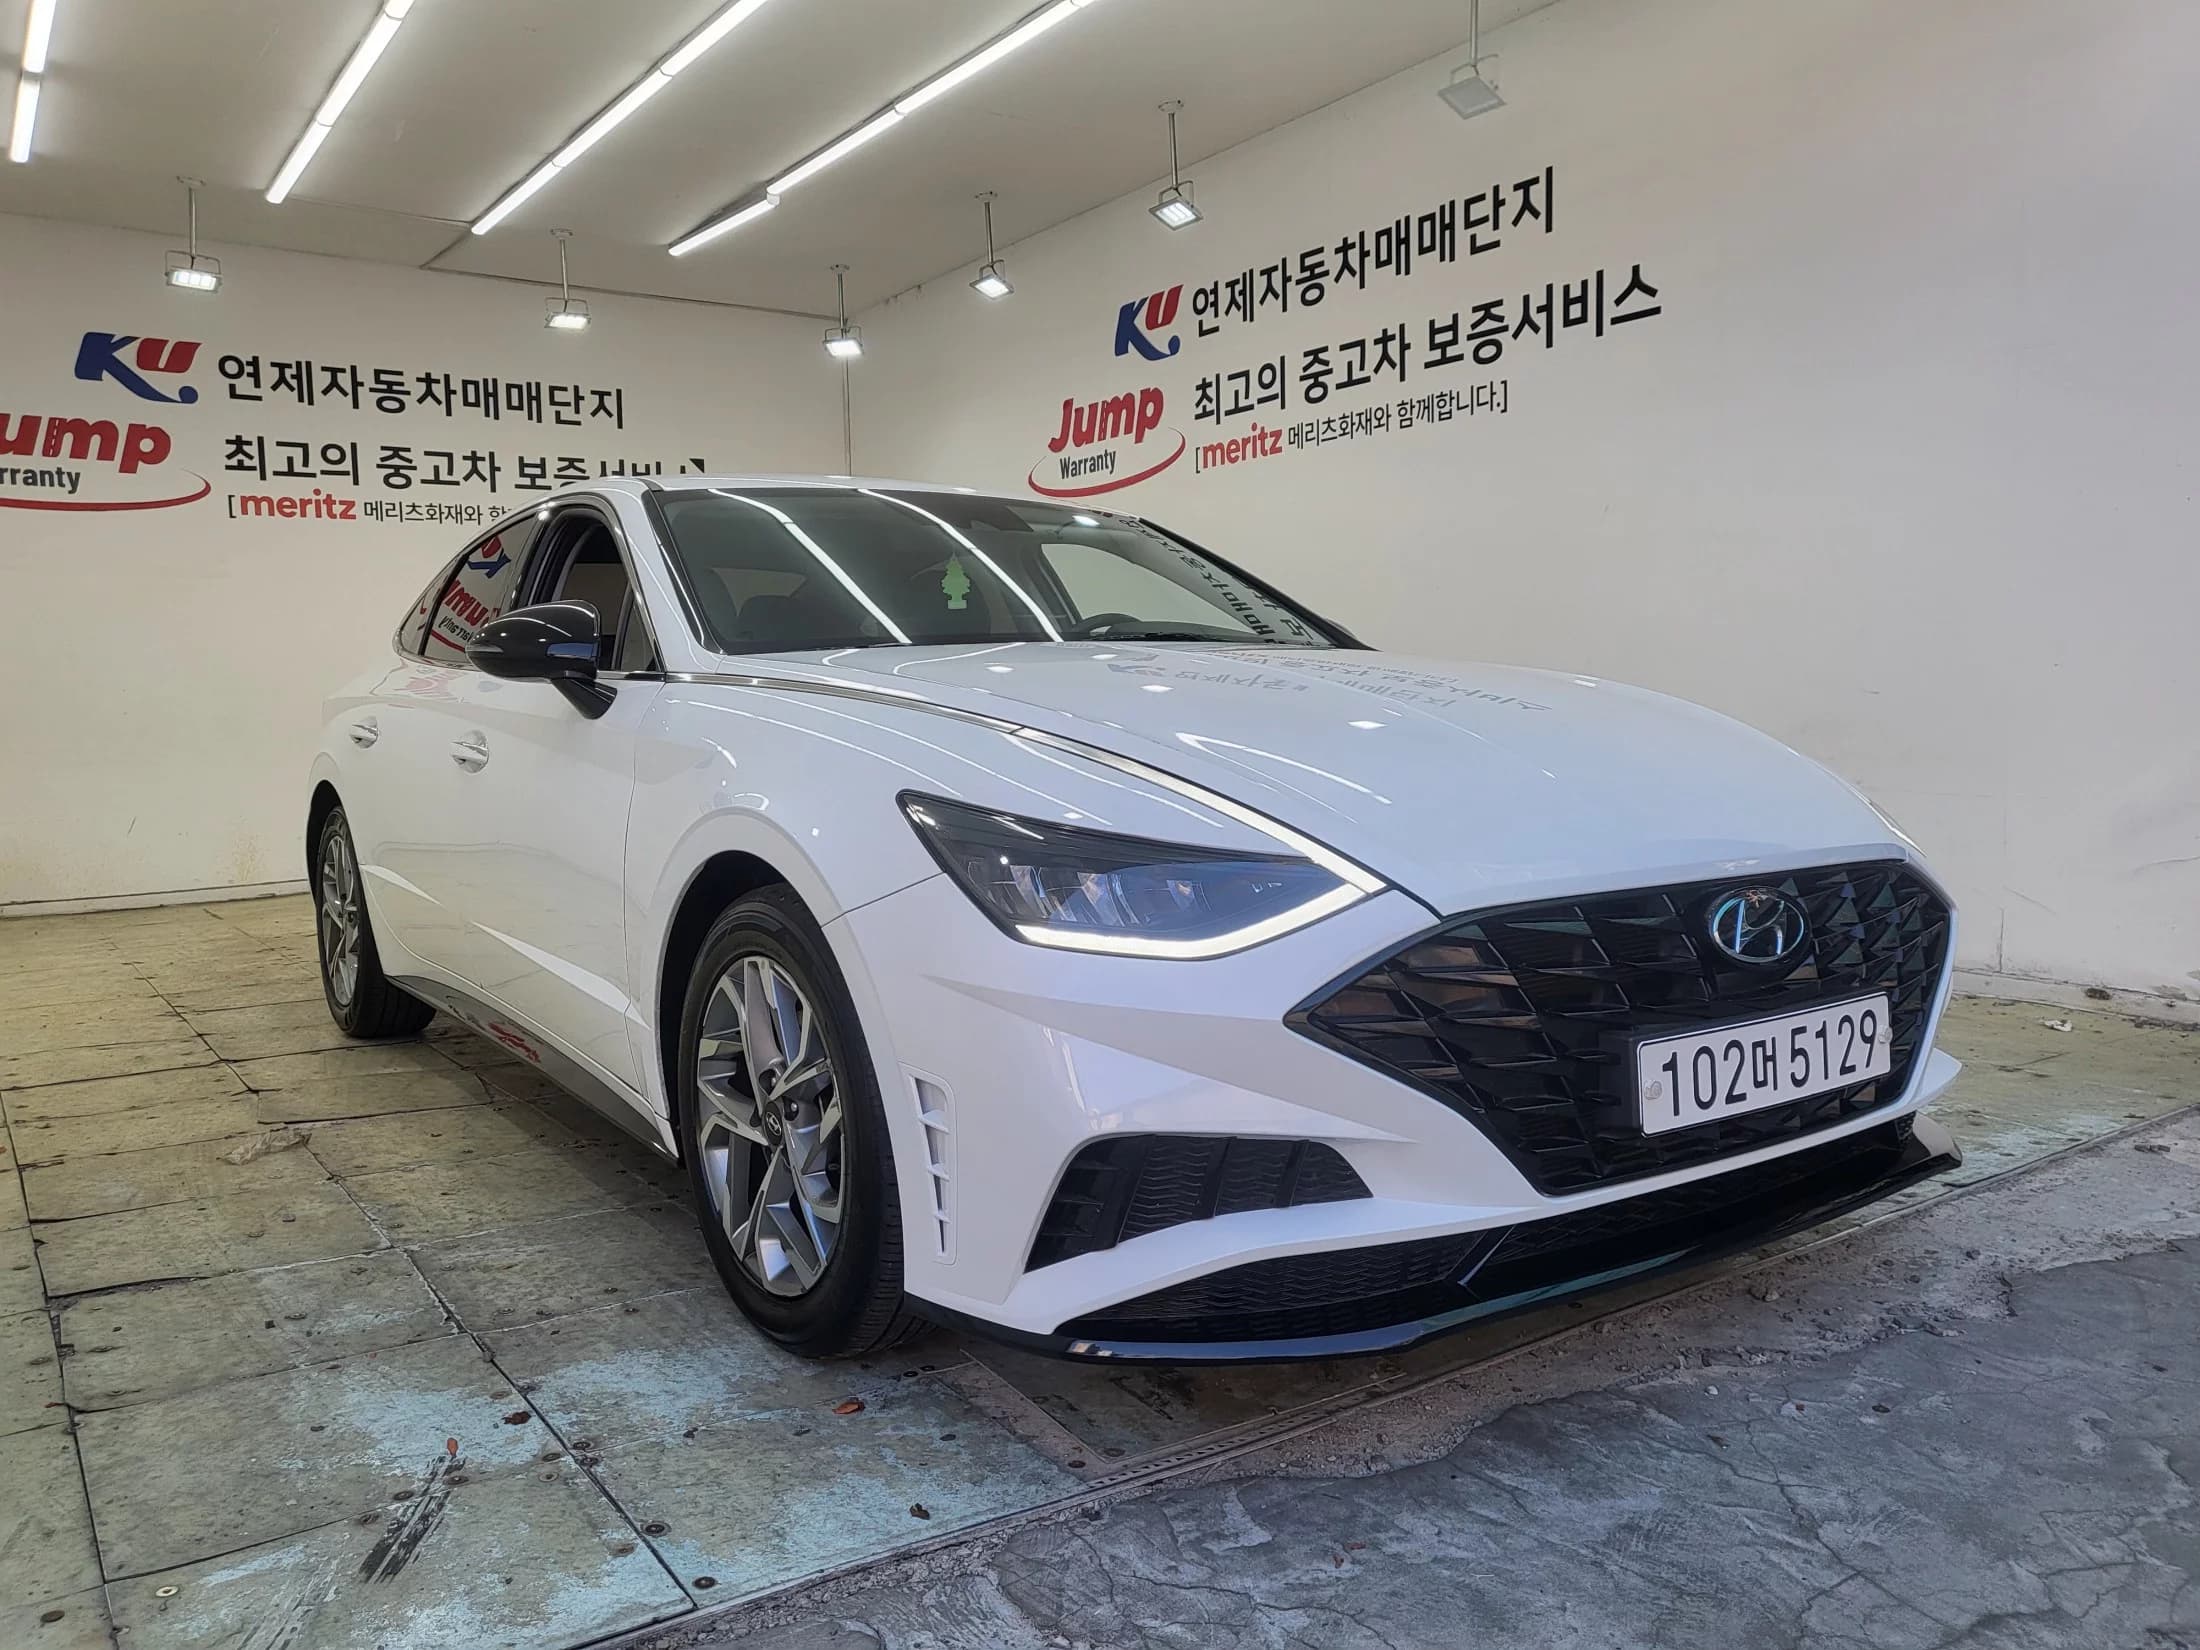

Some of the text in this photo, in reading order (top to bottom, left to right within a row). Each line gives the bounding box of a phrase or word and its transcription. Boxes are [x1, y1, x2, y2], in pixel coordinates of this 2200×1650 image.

[1192, 165, 1554, 338] 연제자동차매매단지
[1194, 263, 1662, 425] 최고의 중고차 보증서비스
[217, 355, 625, 429] 연제자동차매매단지
[1047, 386, 1165, 454] Jump
[0, 412, 172, 475] ump
[1288, 403, 1392, 450] 메리츠화재와
[0, 466, 81, 495] rranty
[224, 434, 360, 487] 최고의
[375, 445, 502, 494] 중고차
[1059, 449, 1117, 480] Warranty
[363, 500, 484, 526] 메리츠화재와
